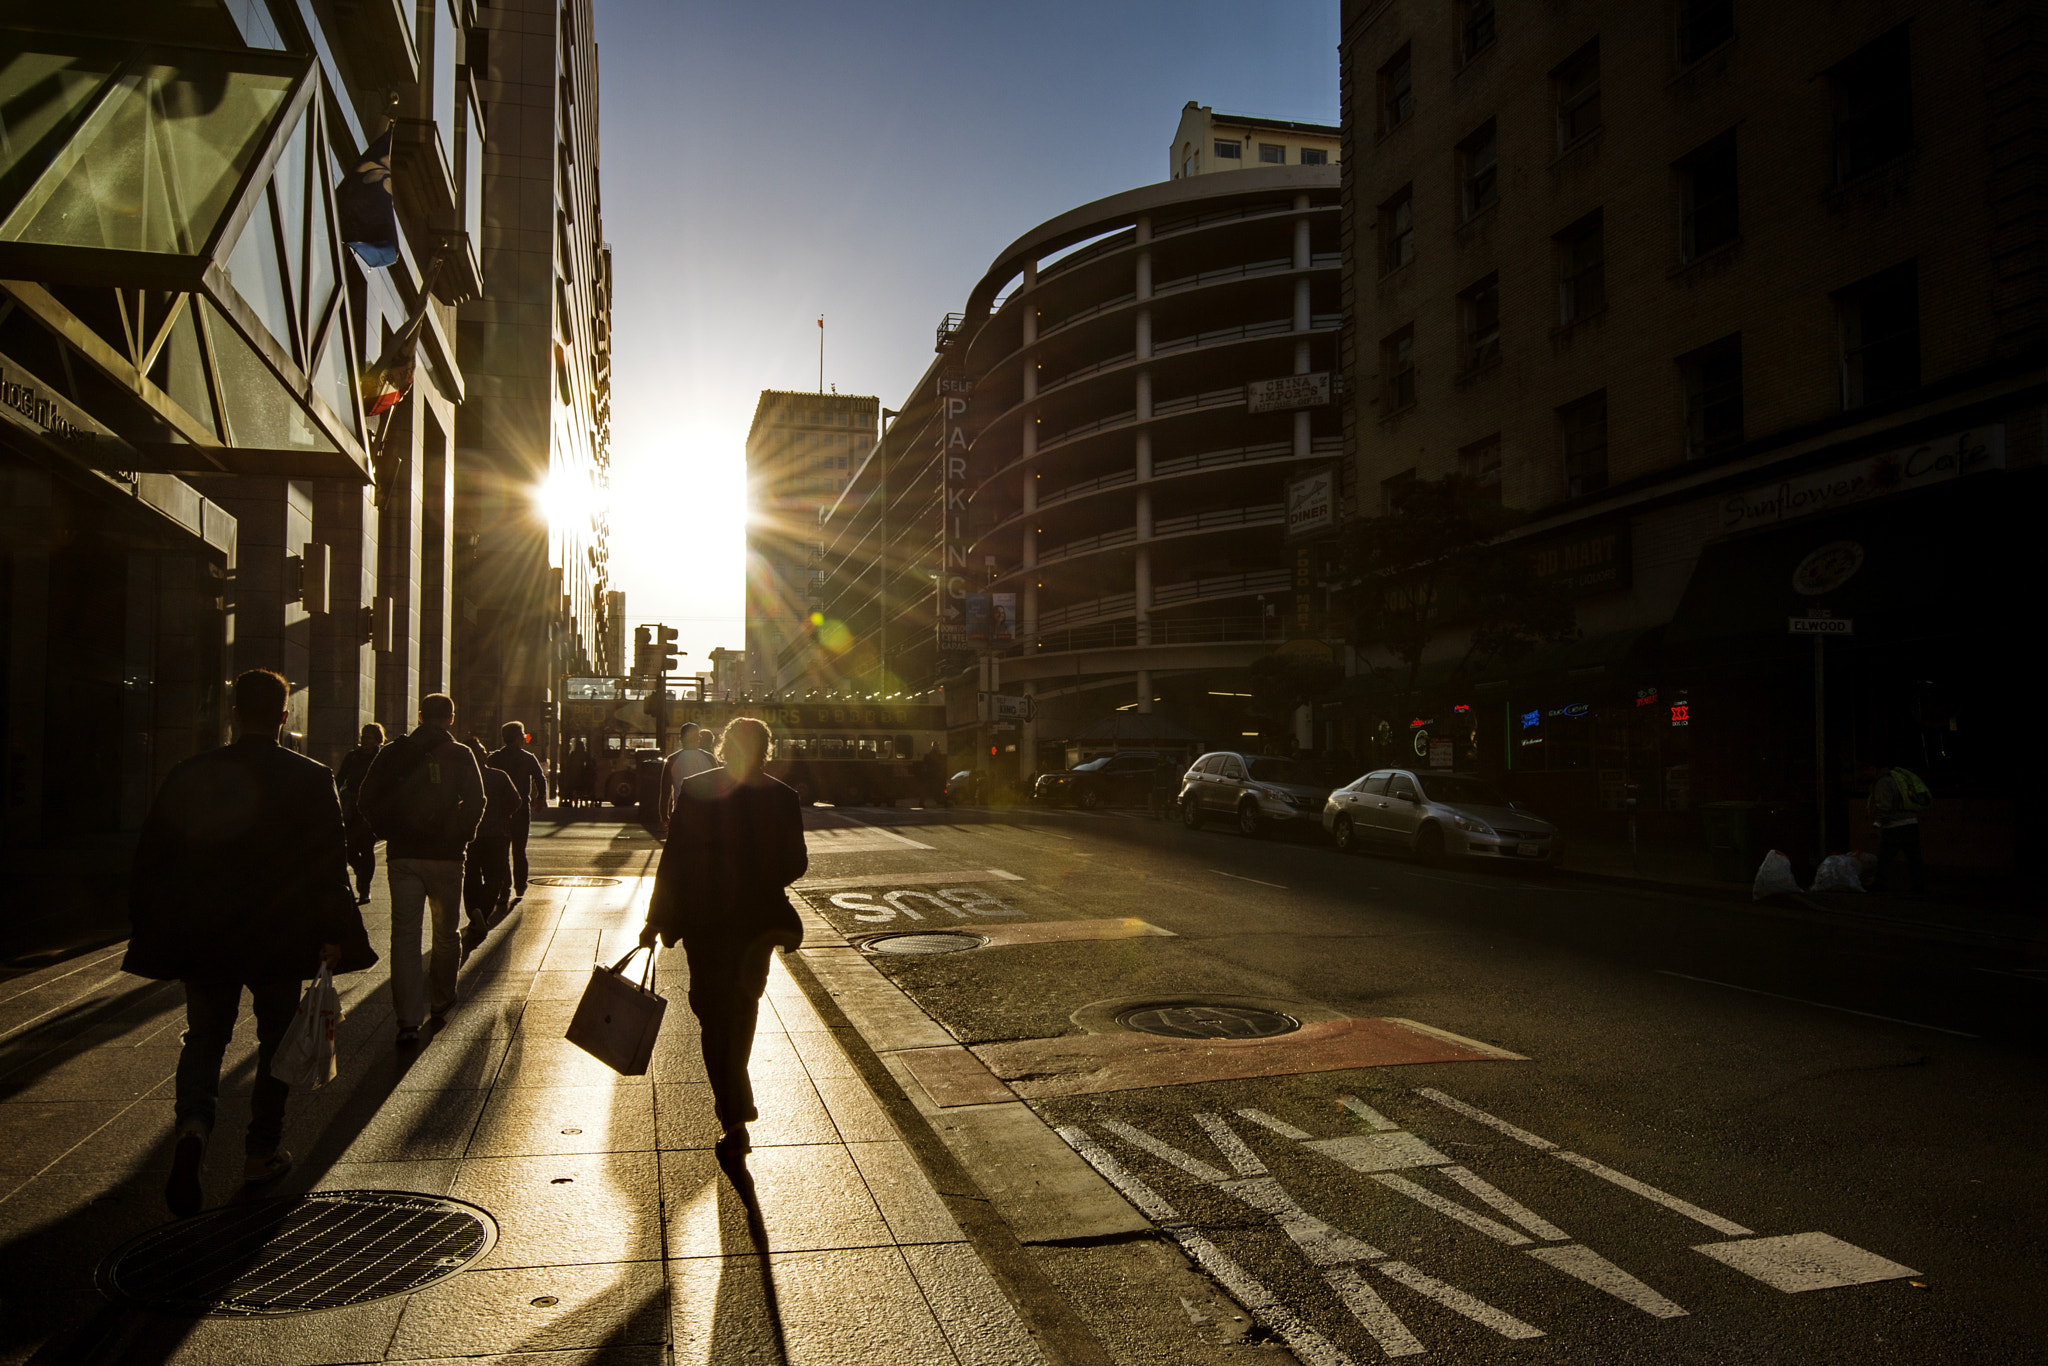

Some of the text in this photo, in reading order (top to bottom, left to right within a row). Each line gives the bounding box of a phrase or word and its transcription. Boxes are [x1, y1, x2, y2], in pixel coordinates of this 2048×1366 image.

[942, 379, 972, 393] SELF
[1266, 377, 1311, 391] CHINA
[1, 372, 36, 422] hotel
[1259, 386, 1318, 403] IMPORTS
[1723, 432, 1989, 526] Sunflower Cafe
[948, 398, 967, 600] PARKING
[1290, 504, 1328, 525] DINER
[1564, 535, 1616, 570] MART
[1297, 549, 1310, 587] FOOD
[1794, 621, 1846, 632] ELWOOD
[942, 633, 968, 642] CENTE
[942, 642, 967, 650] GARAG
[1000, 704, 1018, 716] KING
[829, 887, 1028, 924] BUS
